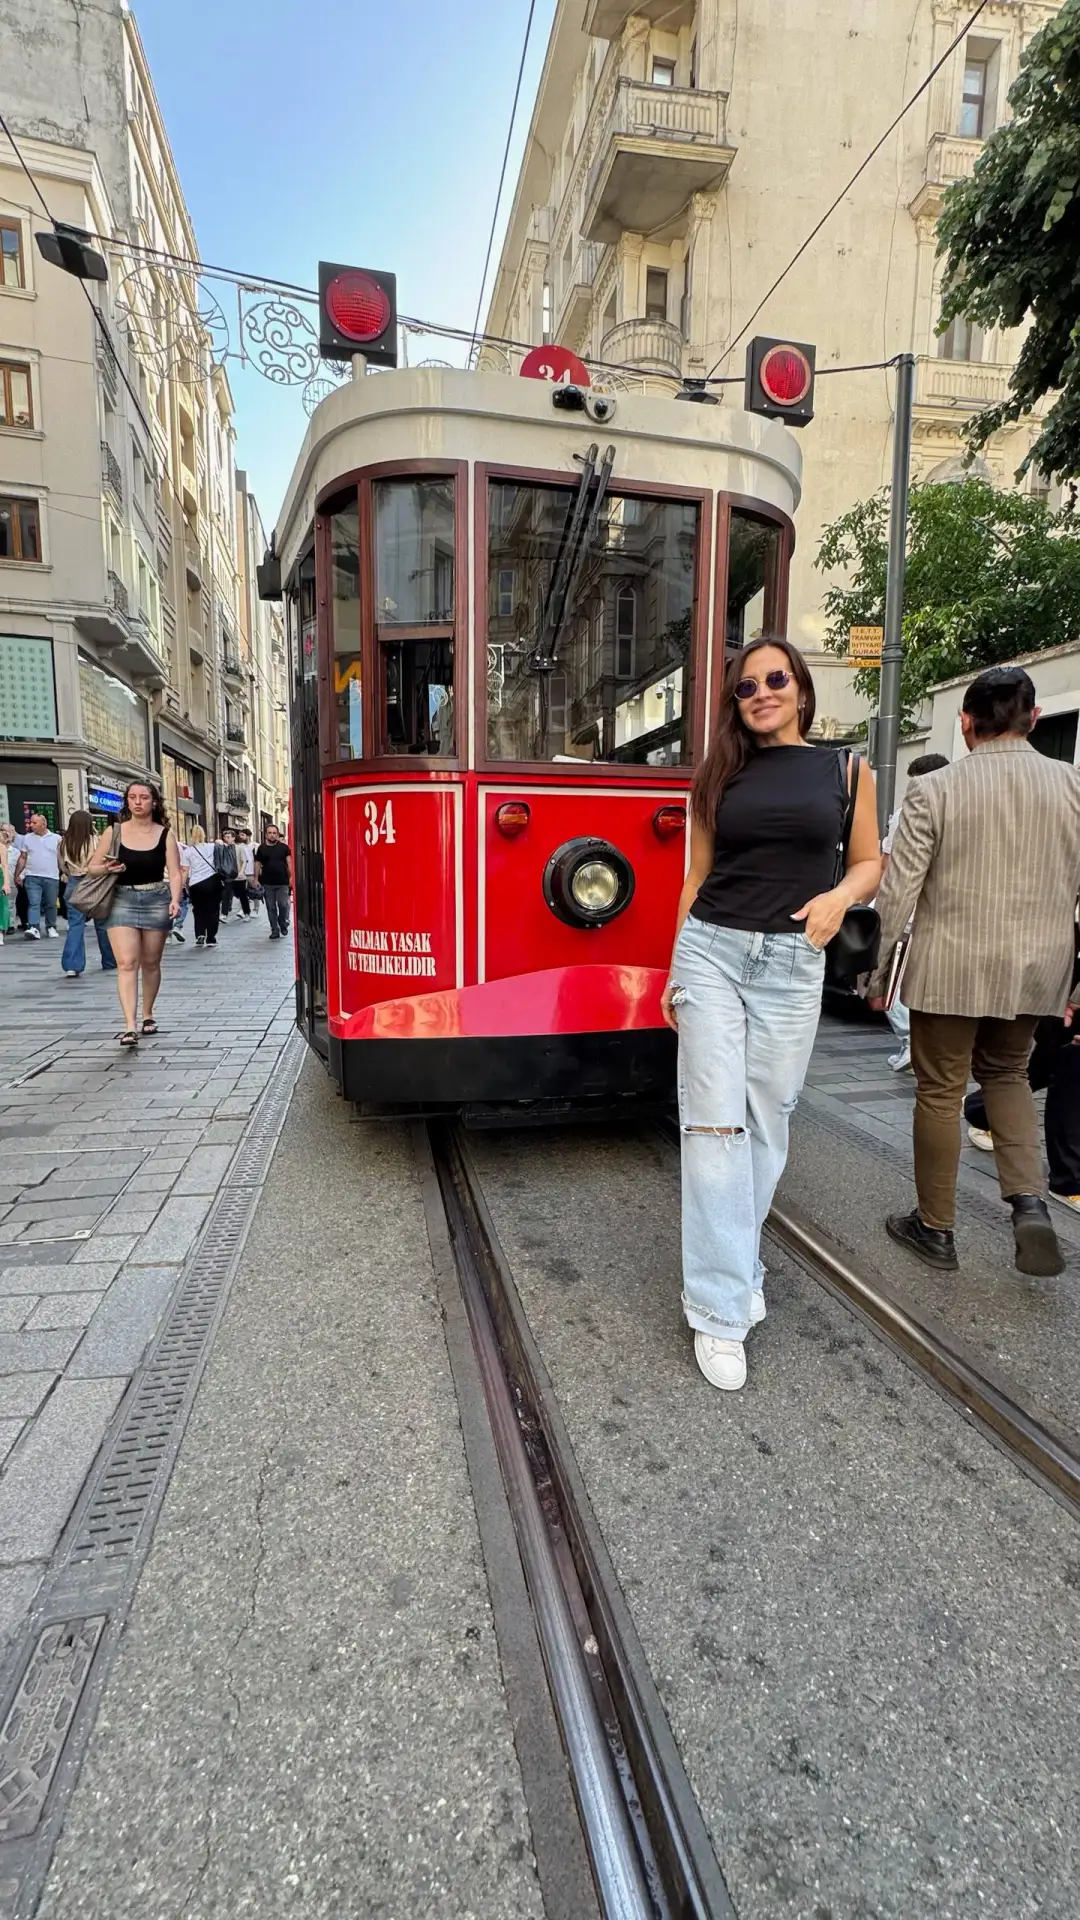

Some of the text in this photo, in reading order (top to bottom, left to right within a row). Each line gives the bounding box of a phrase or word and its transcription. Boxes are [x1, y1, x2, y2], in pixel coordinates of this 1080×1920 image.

[67, 783, 76, 816] EXC
[364, 799, 396, 847] 34
[350, 929, 432, 953] ASILMAK YASAK
[347, 951, 358, 971] VE
